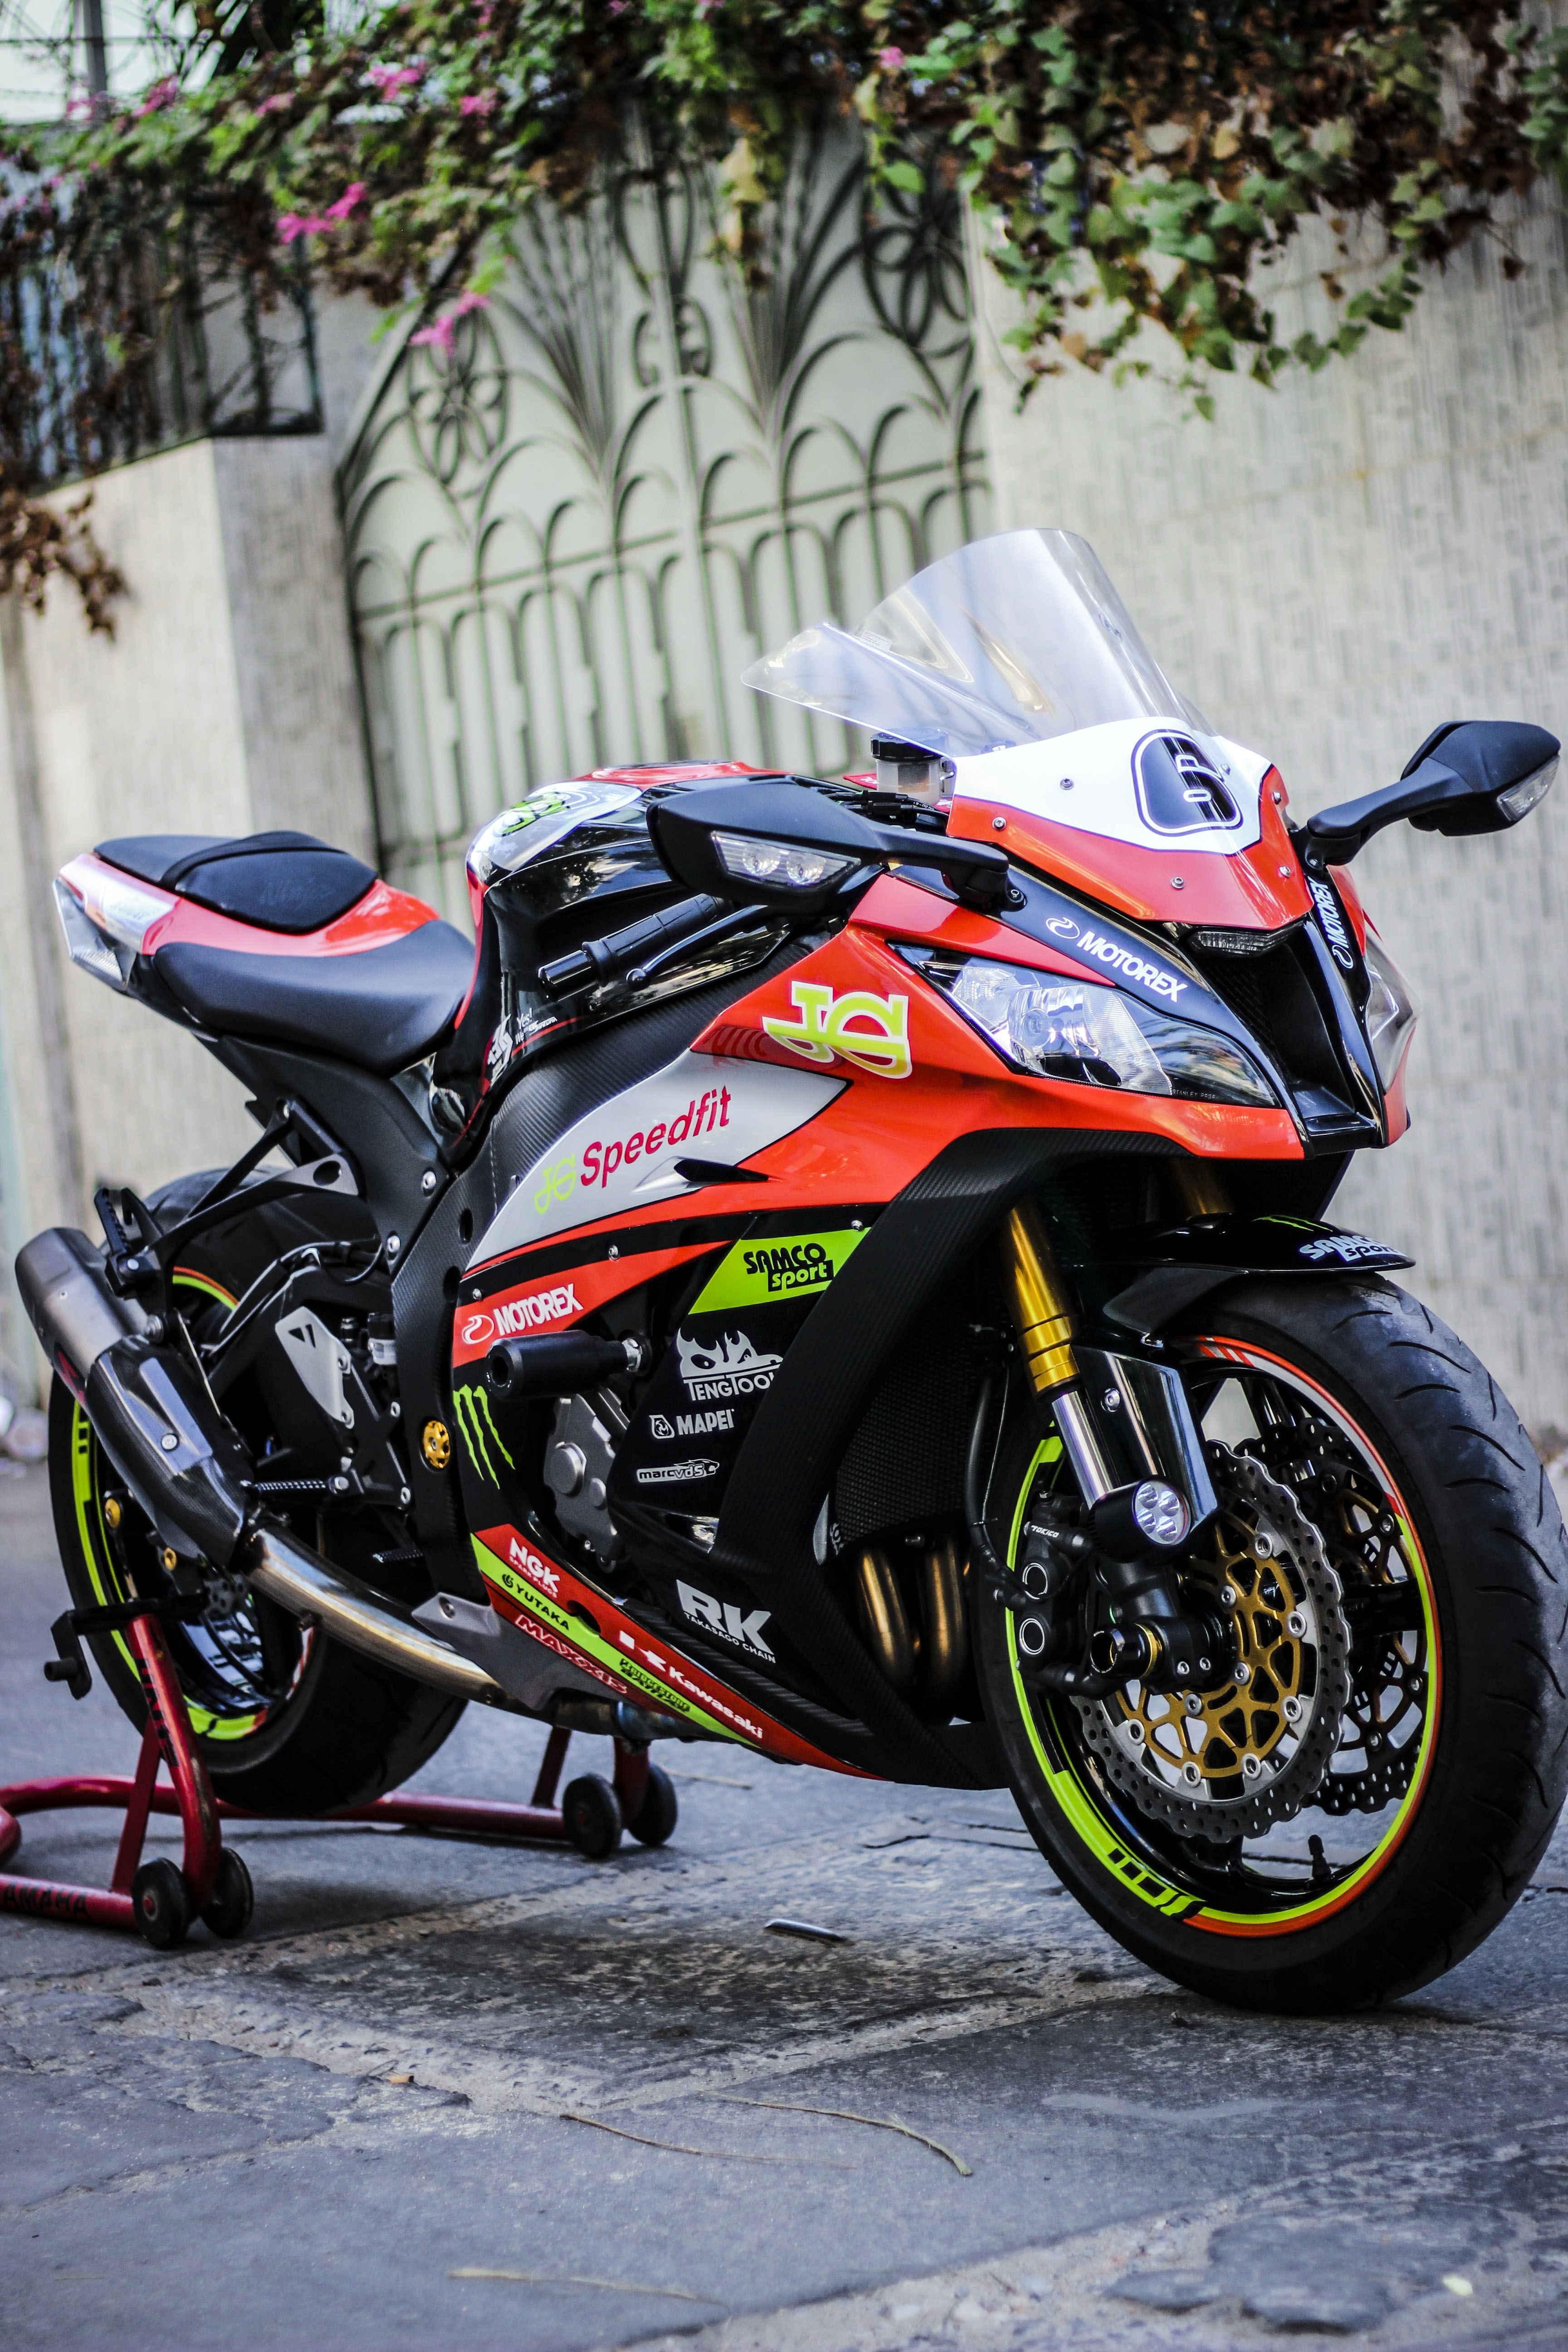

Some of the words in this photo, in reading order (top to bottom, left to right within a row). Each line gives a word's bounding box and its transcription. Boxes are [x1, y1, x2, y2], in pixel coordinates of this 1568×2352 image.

[1308, 876, 1349, 948] MOTOREX
[1077, 931, 1188, 1003] MOTOREX
[517, 1008, 532, 1029] Yes!
[581, 1085, 731, 1188] Speedfit
[744, 1243, 826, 1274] SAMCO
[772, 1262, 827, 1289] sport
[494, 1284, 584, 1336] MOTOREX
[676, 1409, 734, 1435] MAPEI
[1031, 1525, 1059, 1538] TOKICO
[510, 1537, 560, 1592] NGK
[517, 1584, 569, 1630] YUTAKA
[676, 1579, 774, 1655] RK
[515, 1615, 627, 1693] MAXXIS
[684, 1612, 740, 1645] TAKASAGO
[743, 1643, 776, 1663] CHAIN
[670, 1666, 763, 1739] Kawasaki
